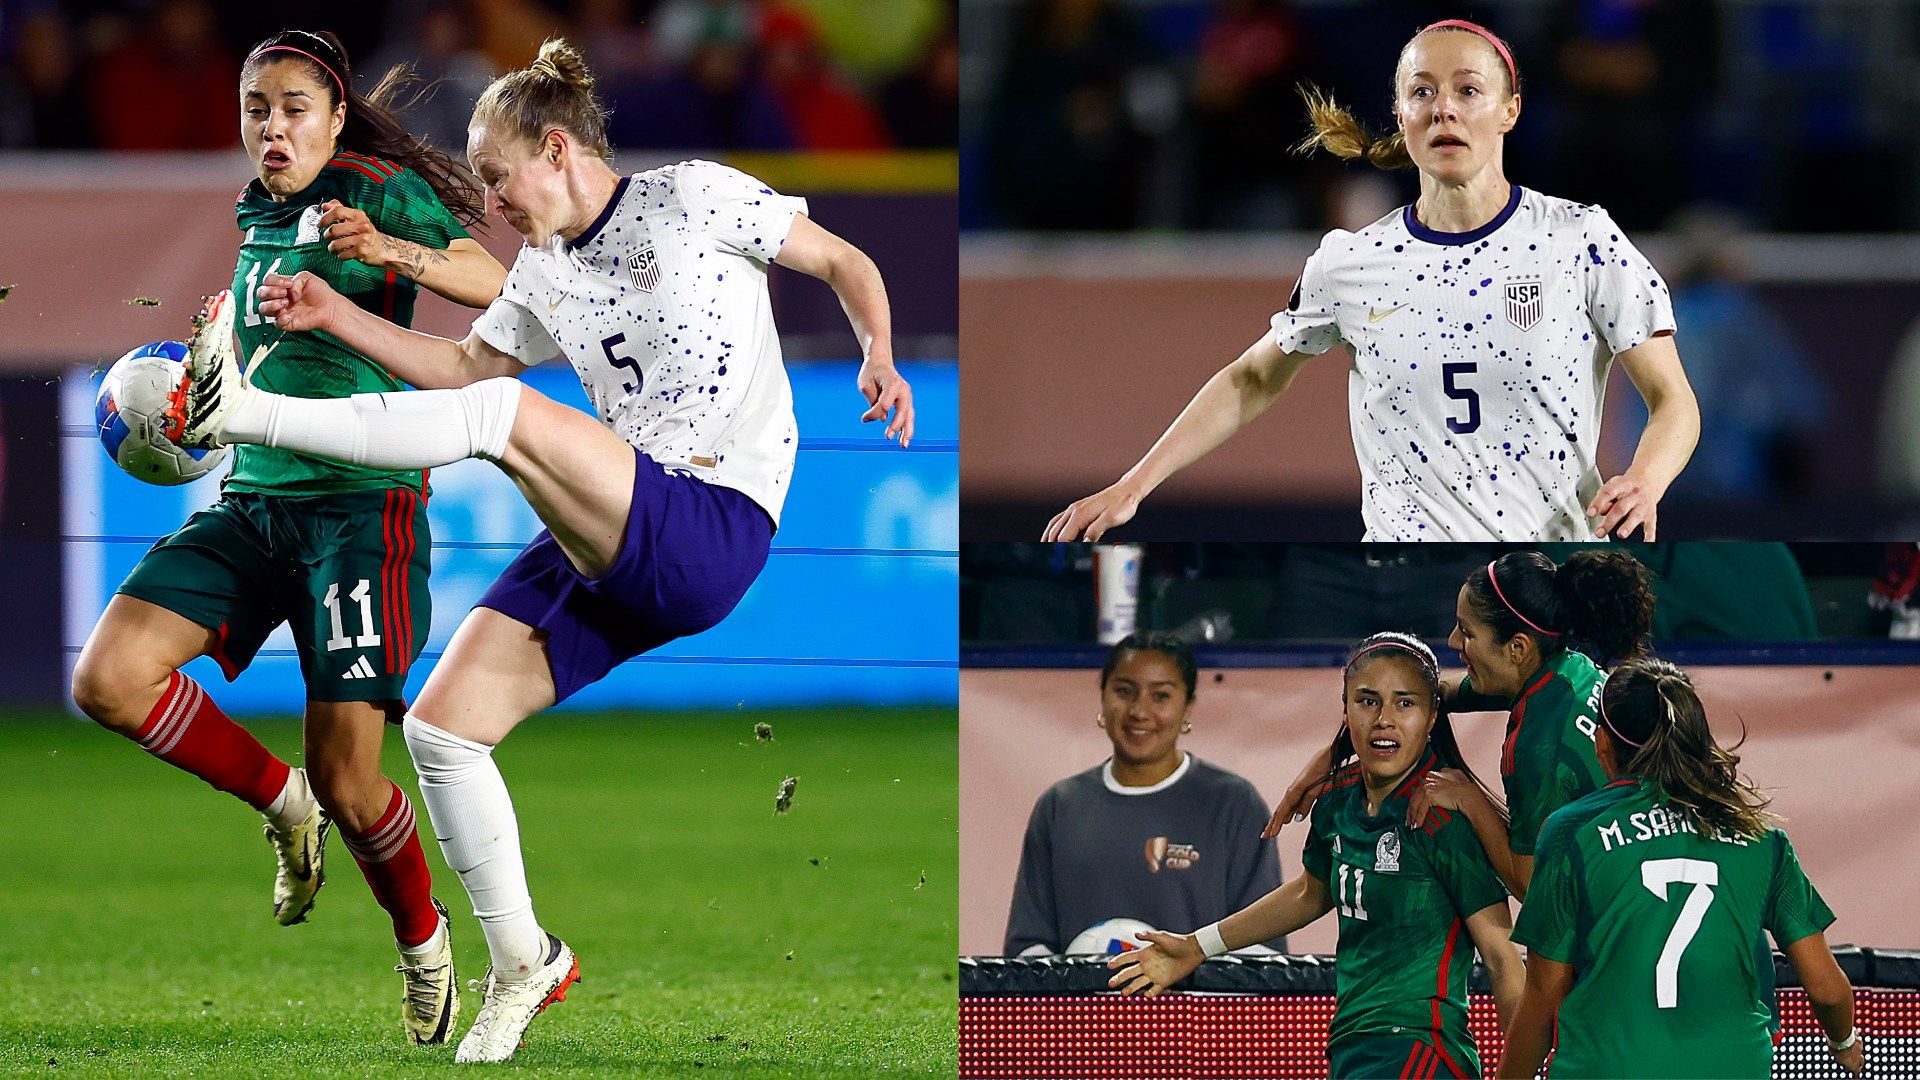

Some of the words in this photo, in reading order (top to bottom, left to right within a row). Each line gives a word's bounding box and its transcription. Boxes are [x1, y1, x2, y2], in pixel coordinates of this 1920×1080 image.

[630, 249, 655, 270] USA
[1507, 285, 1539, 304] USA
[600, 332, 644, 396] 5
[1442, 361, 1481, 434] 5
[323, 579, 381, 652] 11
[1597, 803, 1749, 851] M.SÁN
[1338, 863, 1368, 921] 11
[1640, 857, 1719, 1009] 7
